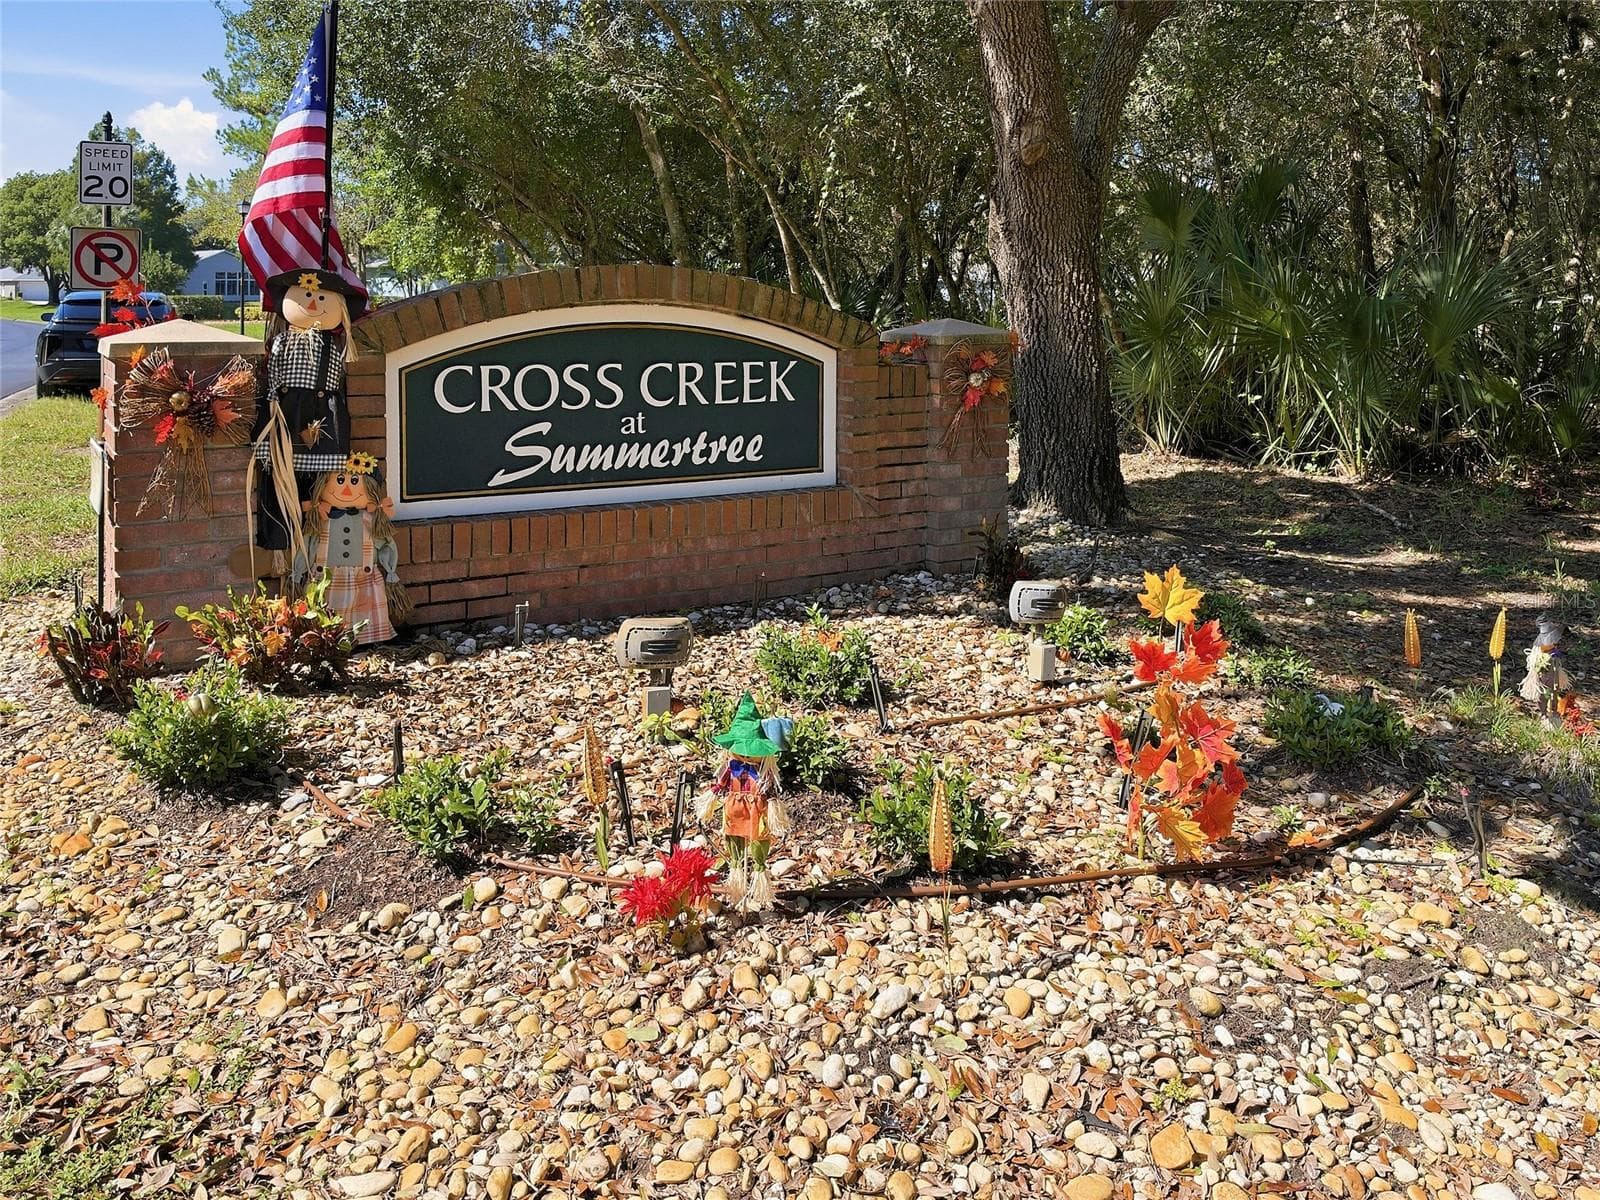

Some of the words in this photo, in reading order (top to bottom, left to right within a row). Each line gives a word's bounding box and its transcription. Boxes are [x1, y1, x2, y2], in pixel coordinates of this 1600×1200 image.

[84, 148, 129, 159] SPEED
[89, 161, 124, 172] LIMIT
[83, 175, 129, 198] 20
[94, 242, 124, 276] P
[433, 363, 624, 414] CROSS
[639, 360, 799, 407] CREEK
[620, 412, 646, 435] at
[487, 421, 764, 487] Summertree
